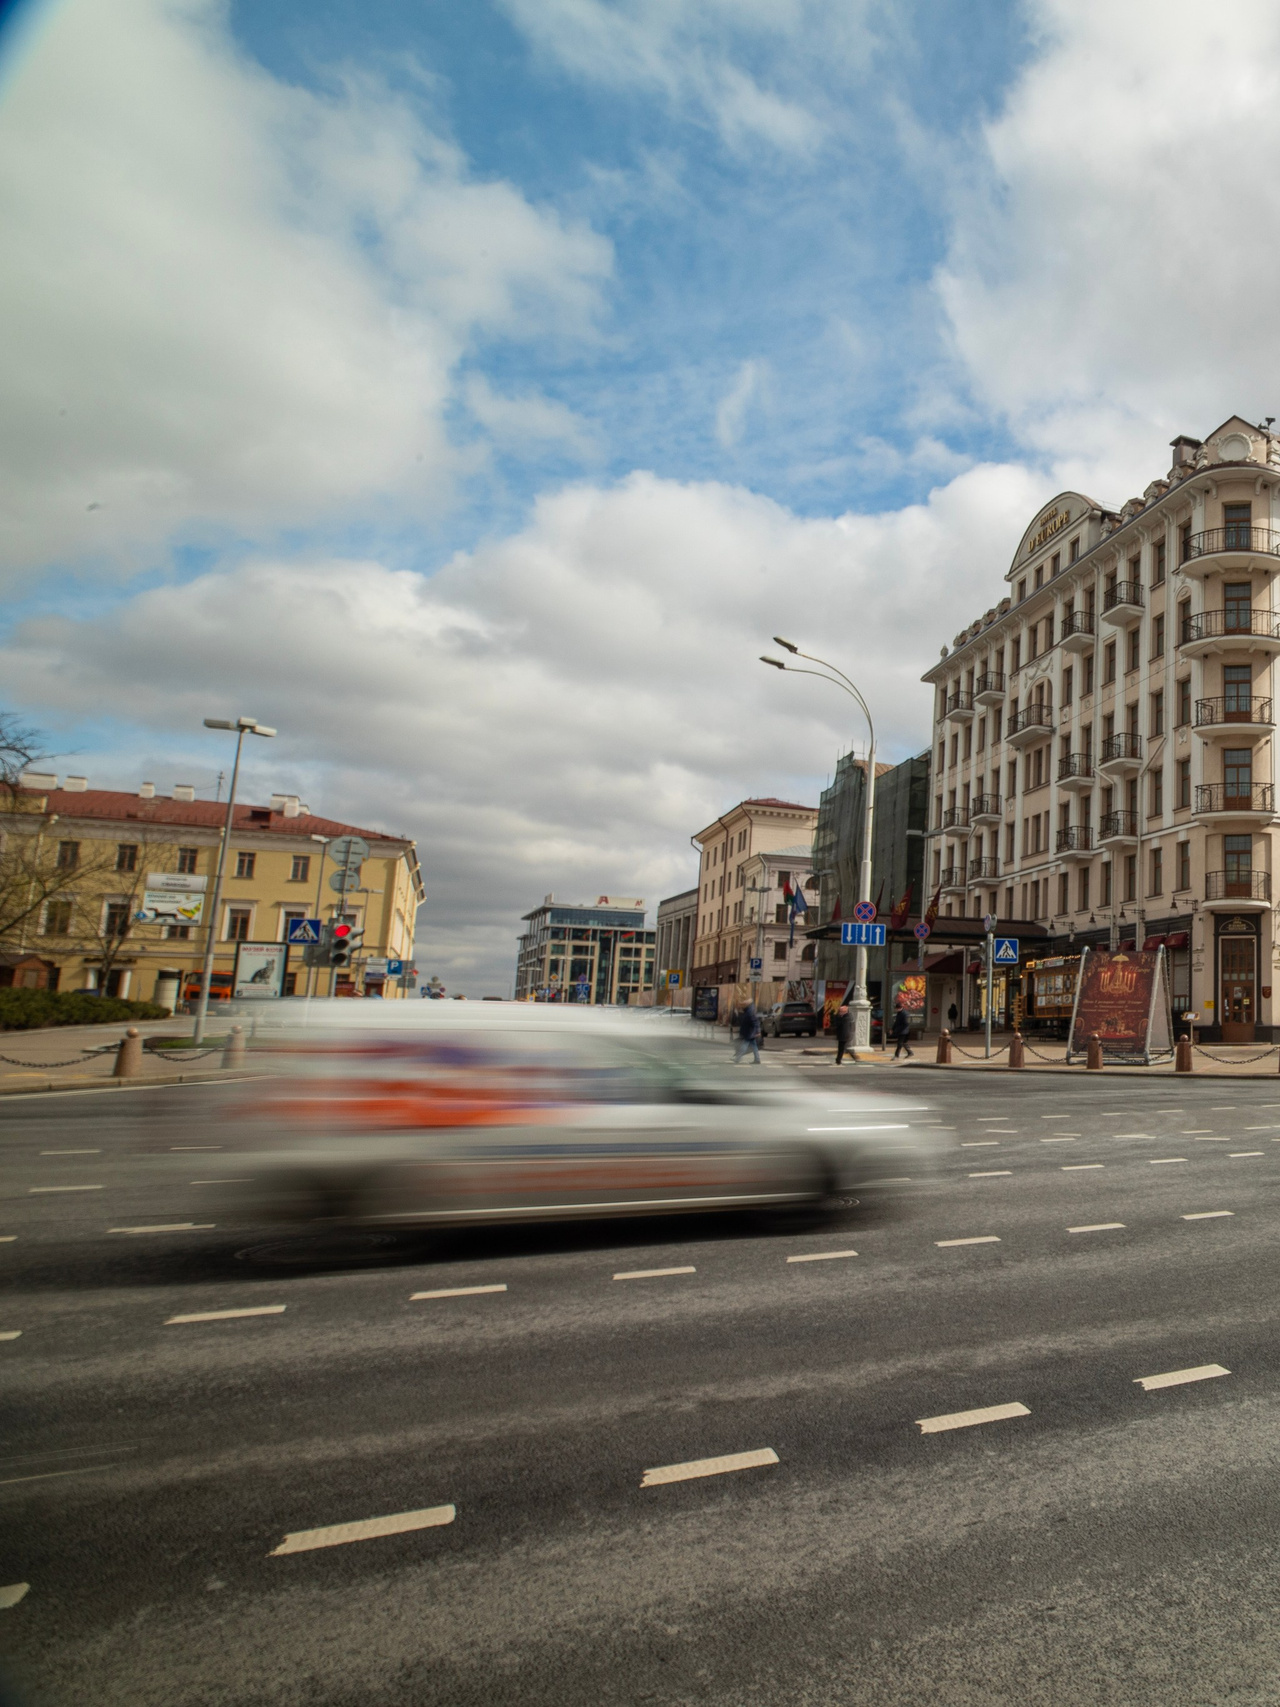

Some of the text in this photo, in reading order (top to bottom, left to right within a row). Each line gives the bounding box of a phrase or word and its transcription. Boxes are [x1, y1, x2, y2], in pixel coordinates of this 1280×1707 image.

[1040, 507, 1057, 528] HOTEL
[1028, 510, 1070, 553] D'EUROPE
[390, 961, 399, 970] P
[752, 959, 760, 968] P
[671, 974, 678, 983] P
